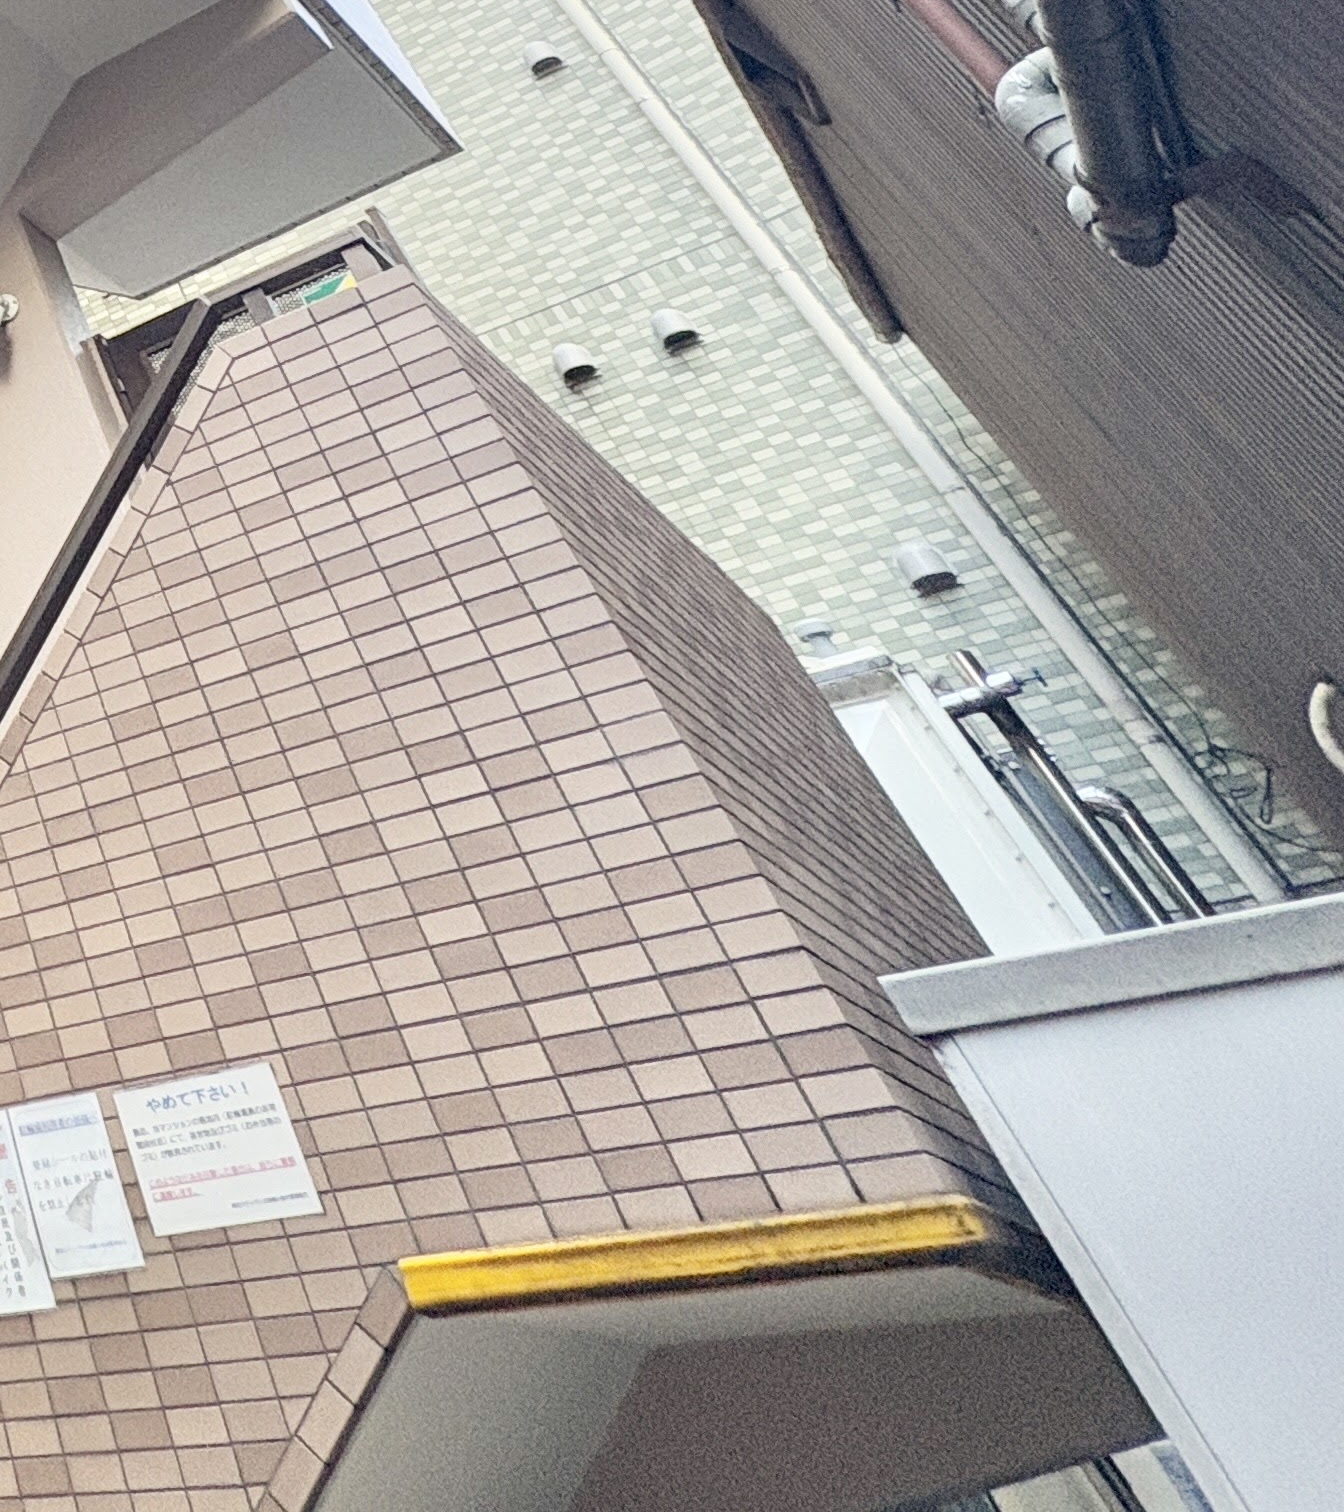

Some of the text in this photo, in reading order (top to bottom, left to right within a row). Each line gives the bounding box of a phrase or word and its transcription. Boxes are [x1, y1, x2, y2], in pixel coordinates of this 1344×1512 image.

[144, 1080, 250, 1114] やめて下さい！
